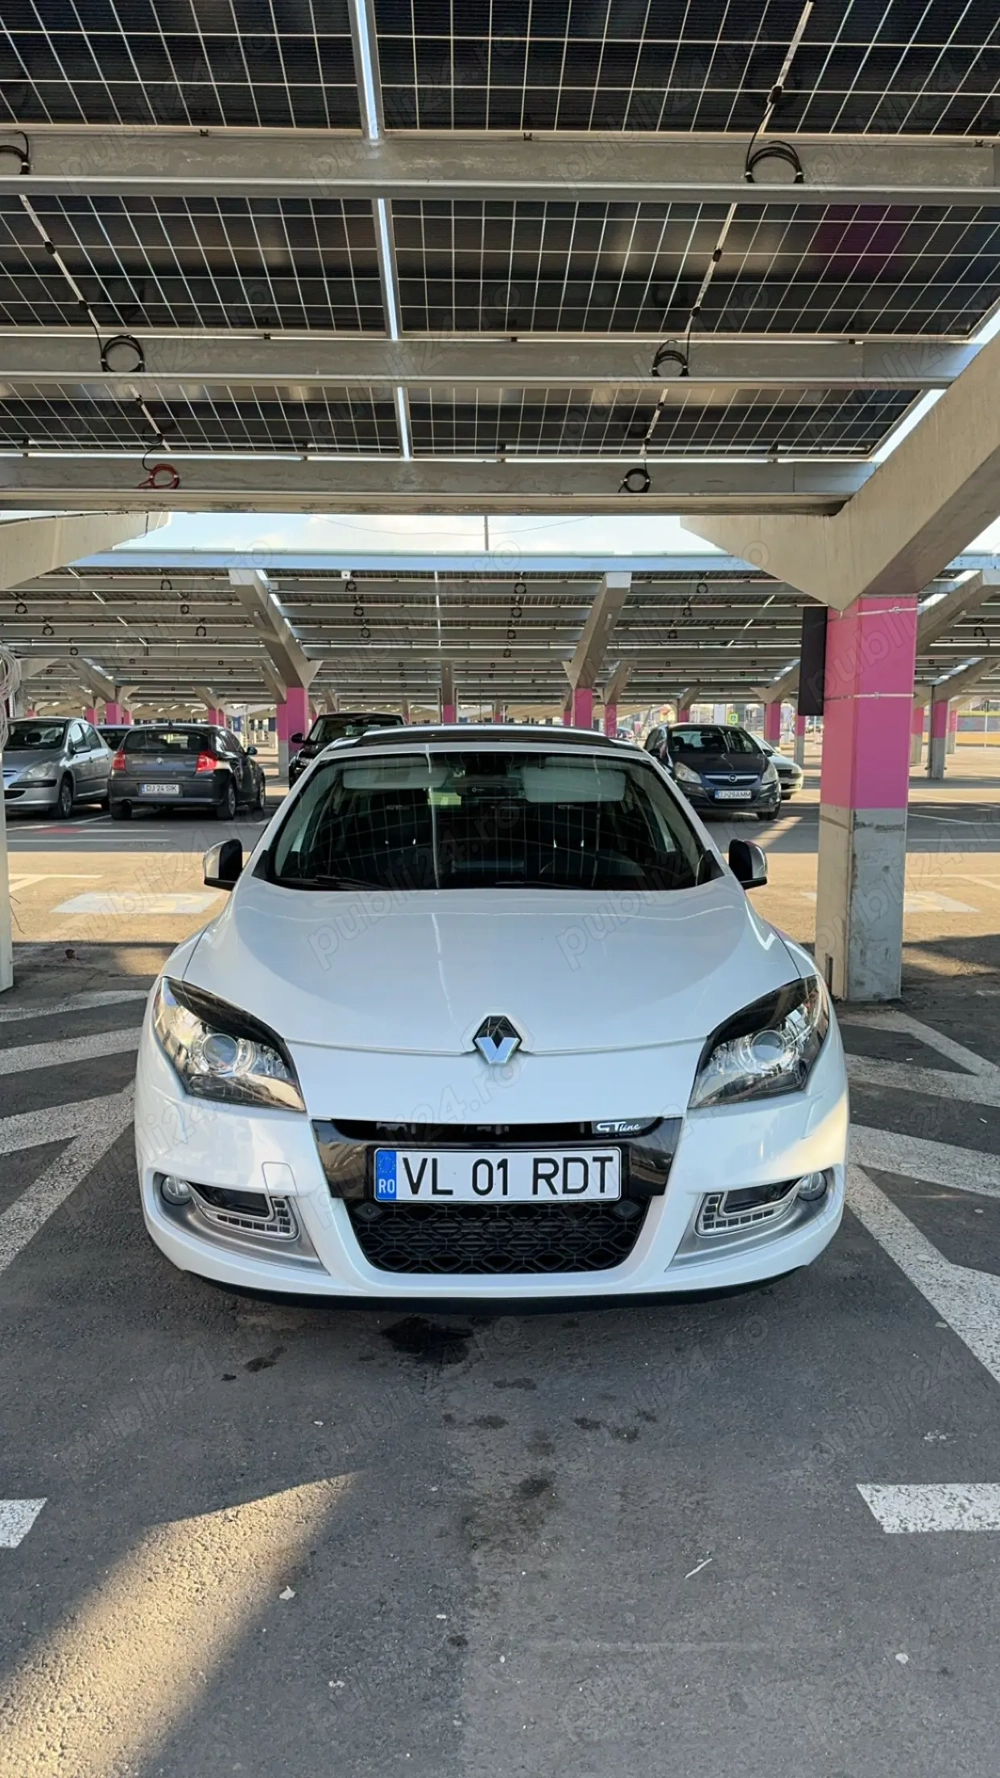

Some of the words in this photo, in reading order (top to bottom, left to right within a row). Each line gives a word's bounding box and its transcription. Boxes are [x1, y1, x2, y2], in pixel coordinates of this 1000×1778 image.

[146, 784, 155, 792] DJ
[156, 784, 165, 792] 24
[402, 1157, 454, 1196] VL
[472, 1158, 508, 1196] 01
[532, 1156, 614, 1196] RDT
[378, 1179, 395, 1194] RO
